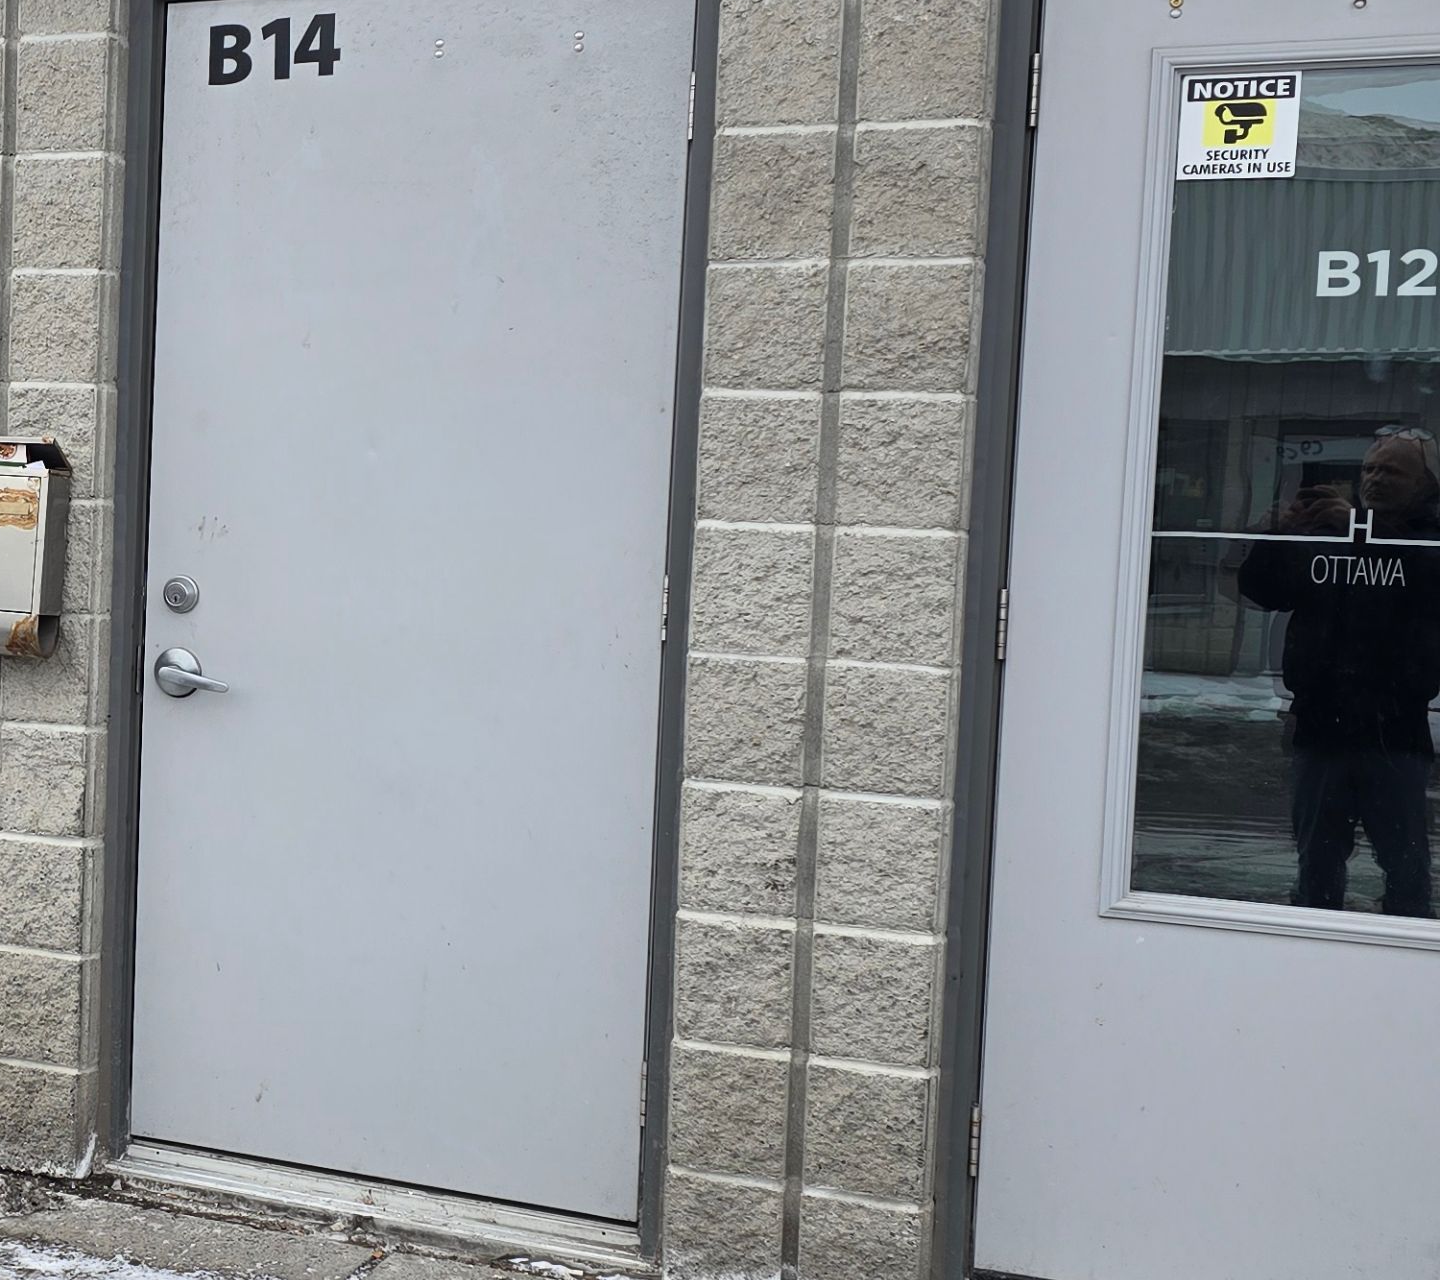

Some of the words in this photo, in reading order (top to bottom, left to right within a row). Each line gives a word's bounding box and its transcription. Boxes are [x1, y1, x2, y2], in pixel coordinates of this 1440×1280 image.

[208, 13, 341, 85] B14
[1193, 78, 1291, 100] NOTICE
[1182, 163, 1243, 175] CAMERAS
[1247, 162, 1262, 174] IN
[1266, 161, 1291, 173] USE
[1206, 148, 1270, 161] SECURITY
[1316, 249, 1438, 296] B12
[1311, 555, 1406, 587] OTTAWA
